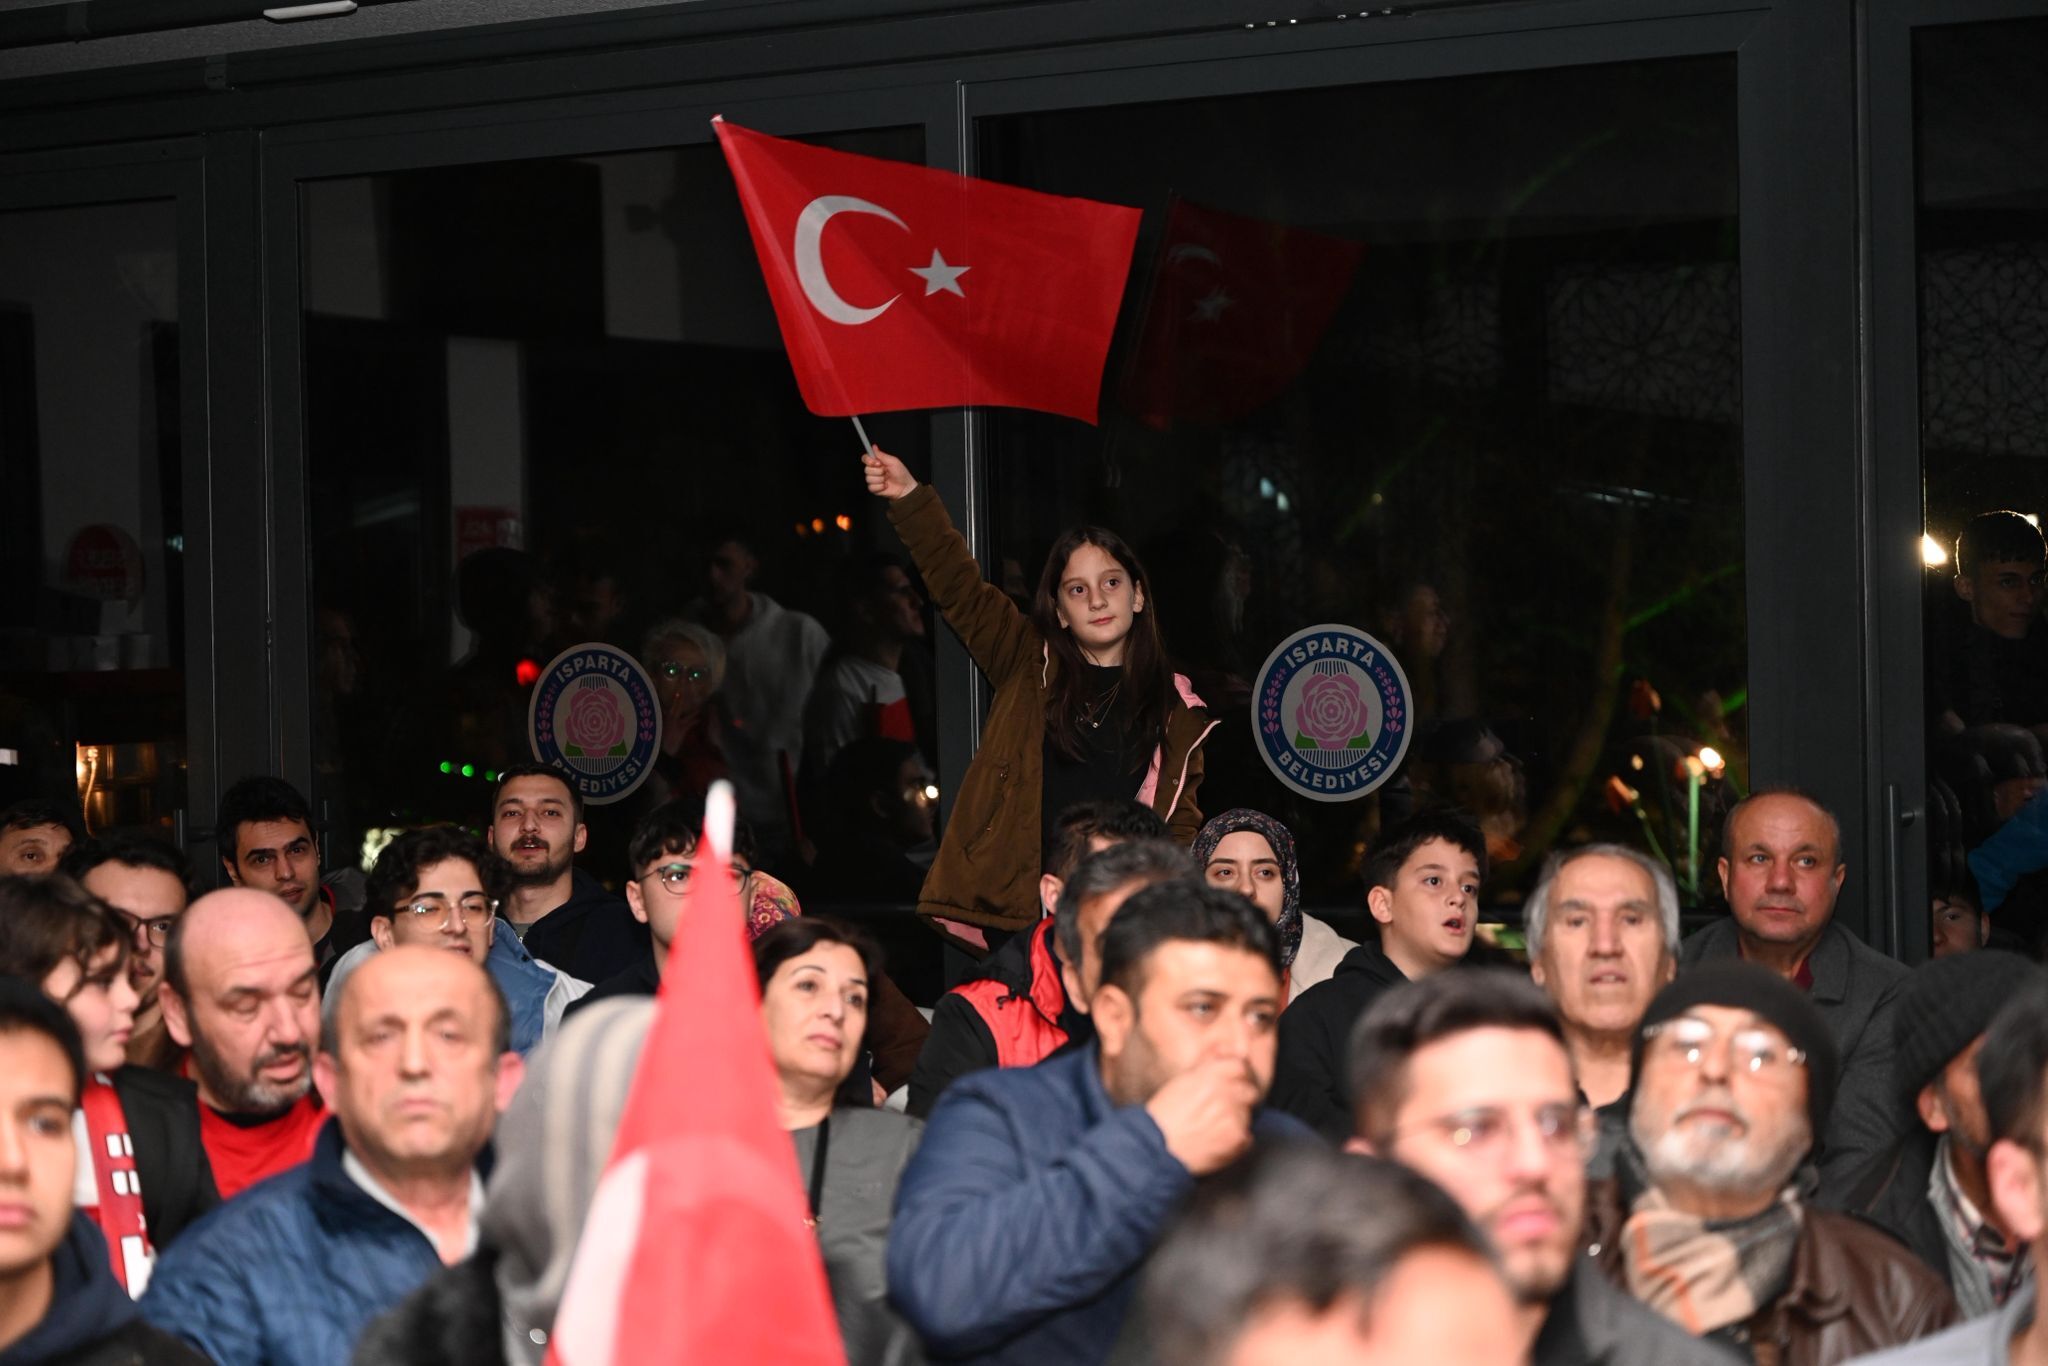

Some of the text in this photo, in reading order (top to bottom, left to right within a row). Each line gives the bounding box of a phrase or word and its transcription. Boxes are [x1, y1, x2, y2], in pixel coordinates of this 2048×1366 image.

[557, 655, 629, 683] ISPARTA
[1284, 637, 1375, 669] ISPARTA
[1278, 750, 1388, 788] BELEDİYESİ
